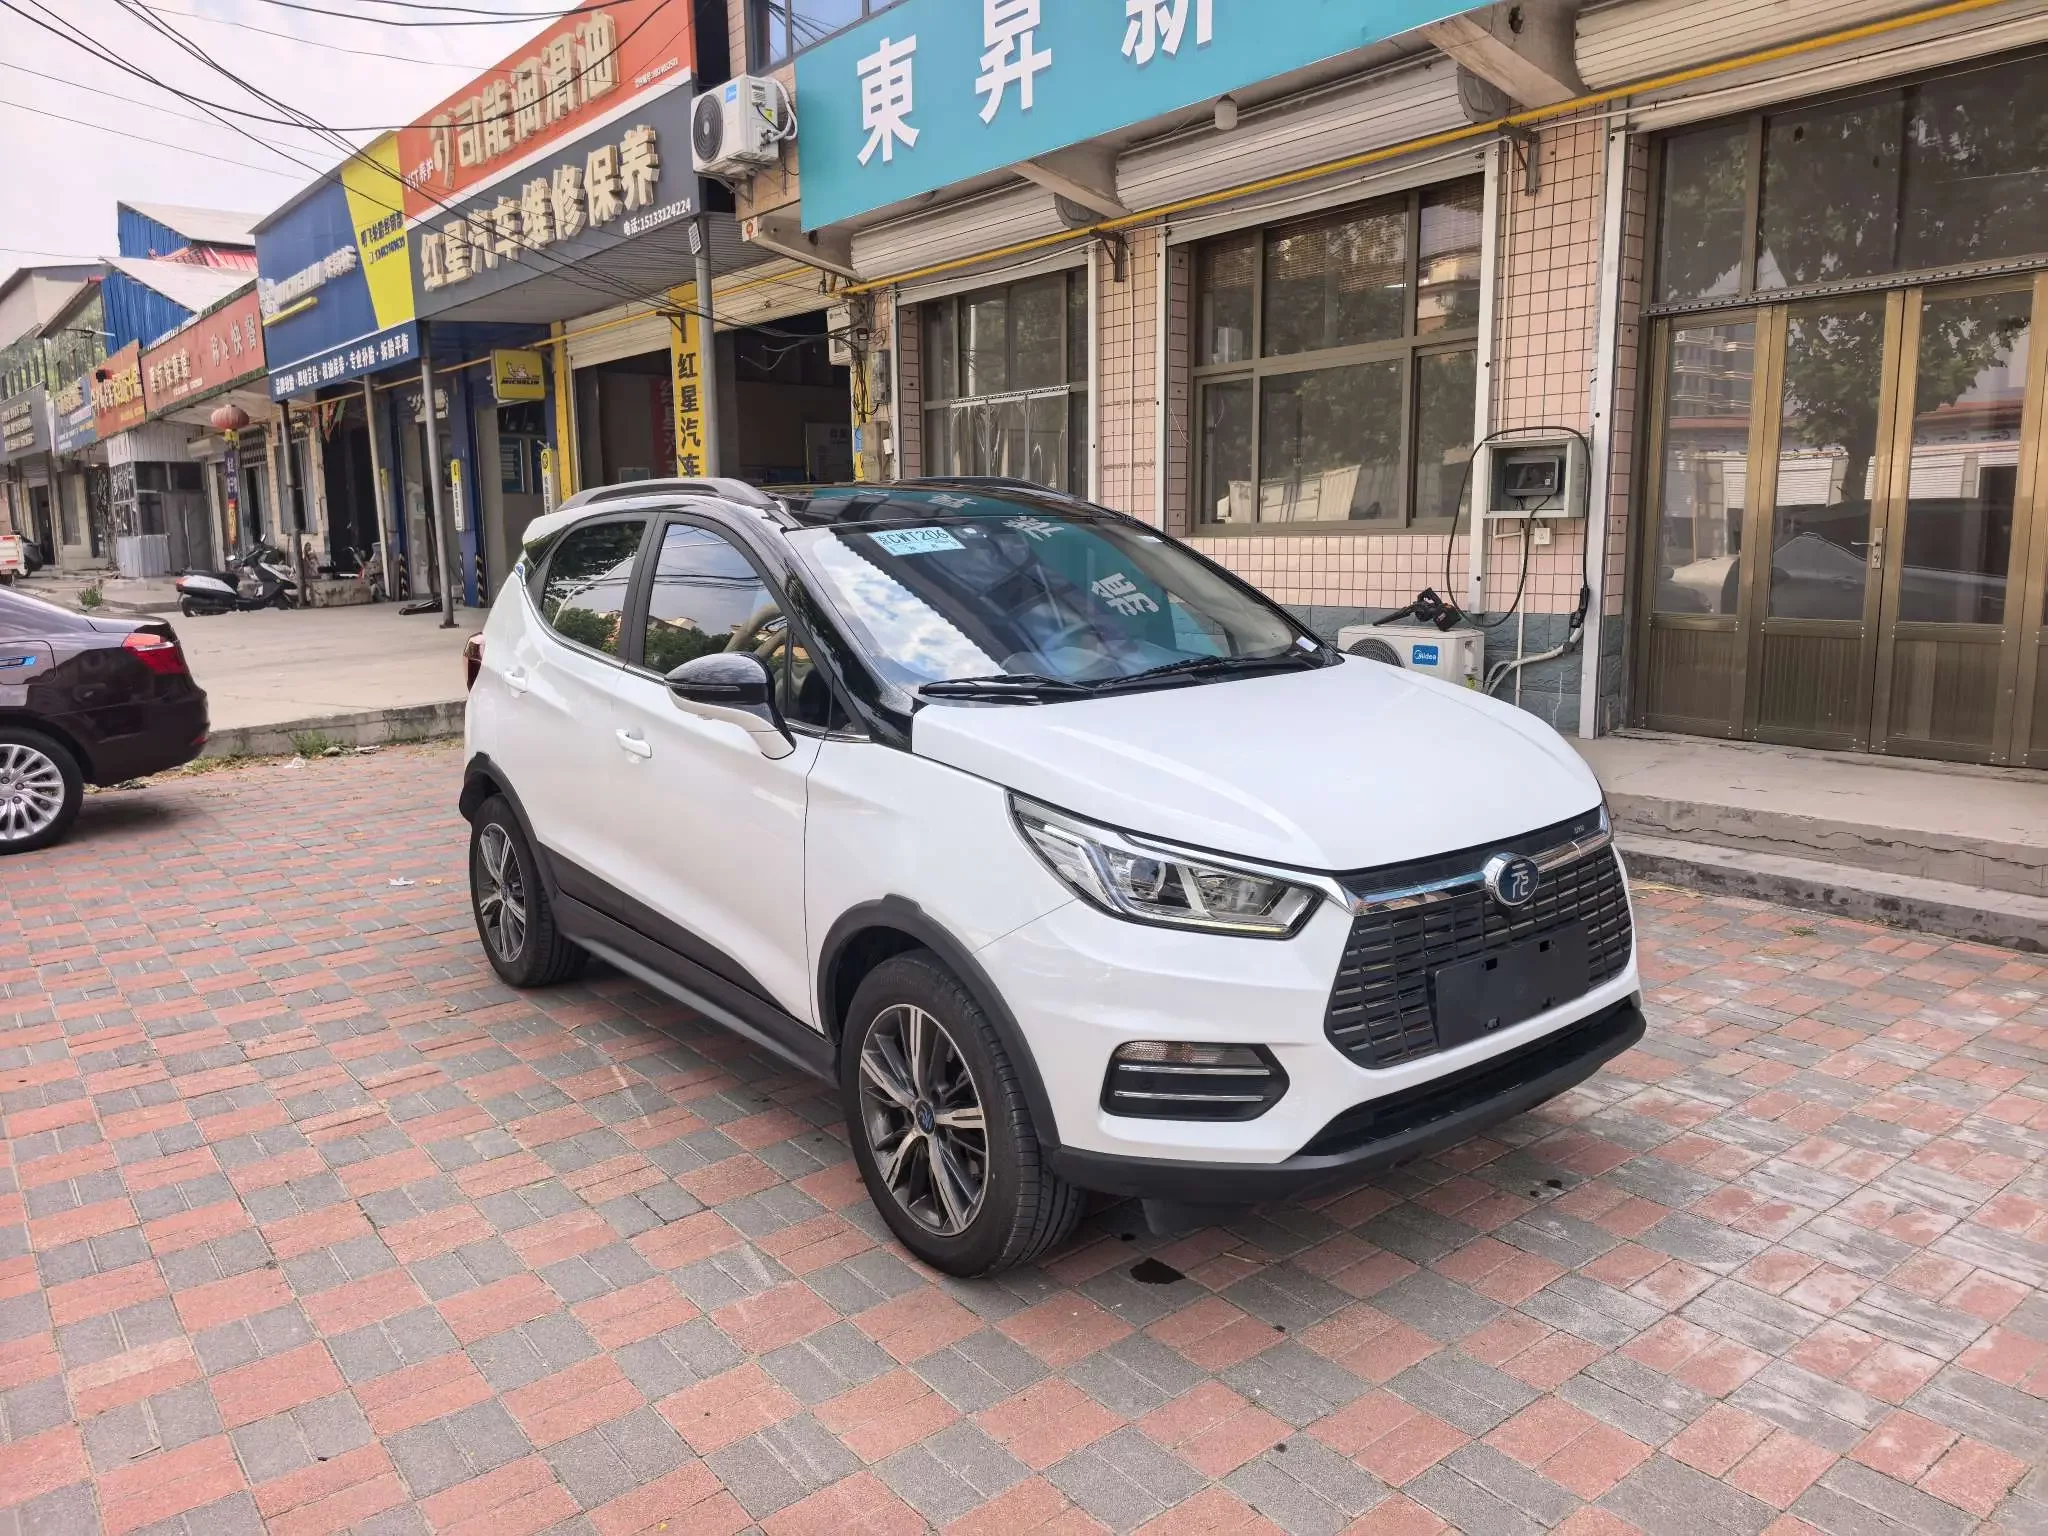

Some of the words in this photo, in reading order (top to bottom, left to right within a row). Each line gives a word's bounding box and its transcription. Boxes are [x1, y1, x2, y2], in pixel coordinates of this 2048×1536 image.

[421, 124, 660, 291] 红星汽车维修保养
[678, 352, 701, 477] 红星汽车
[1414, 649, 1437, 661] Midea
